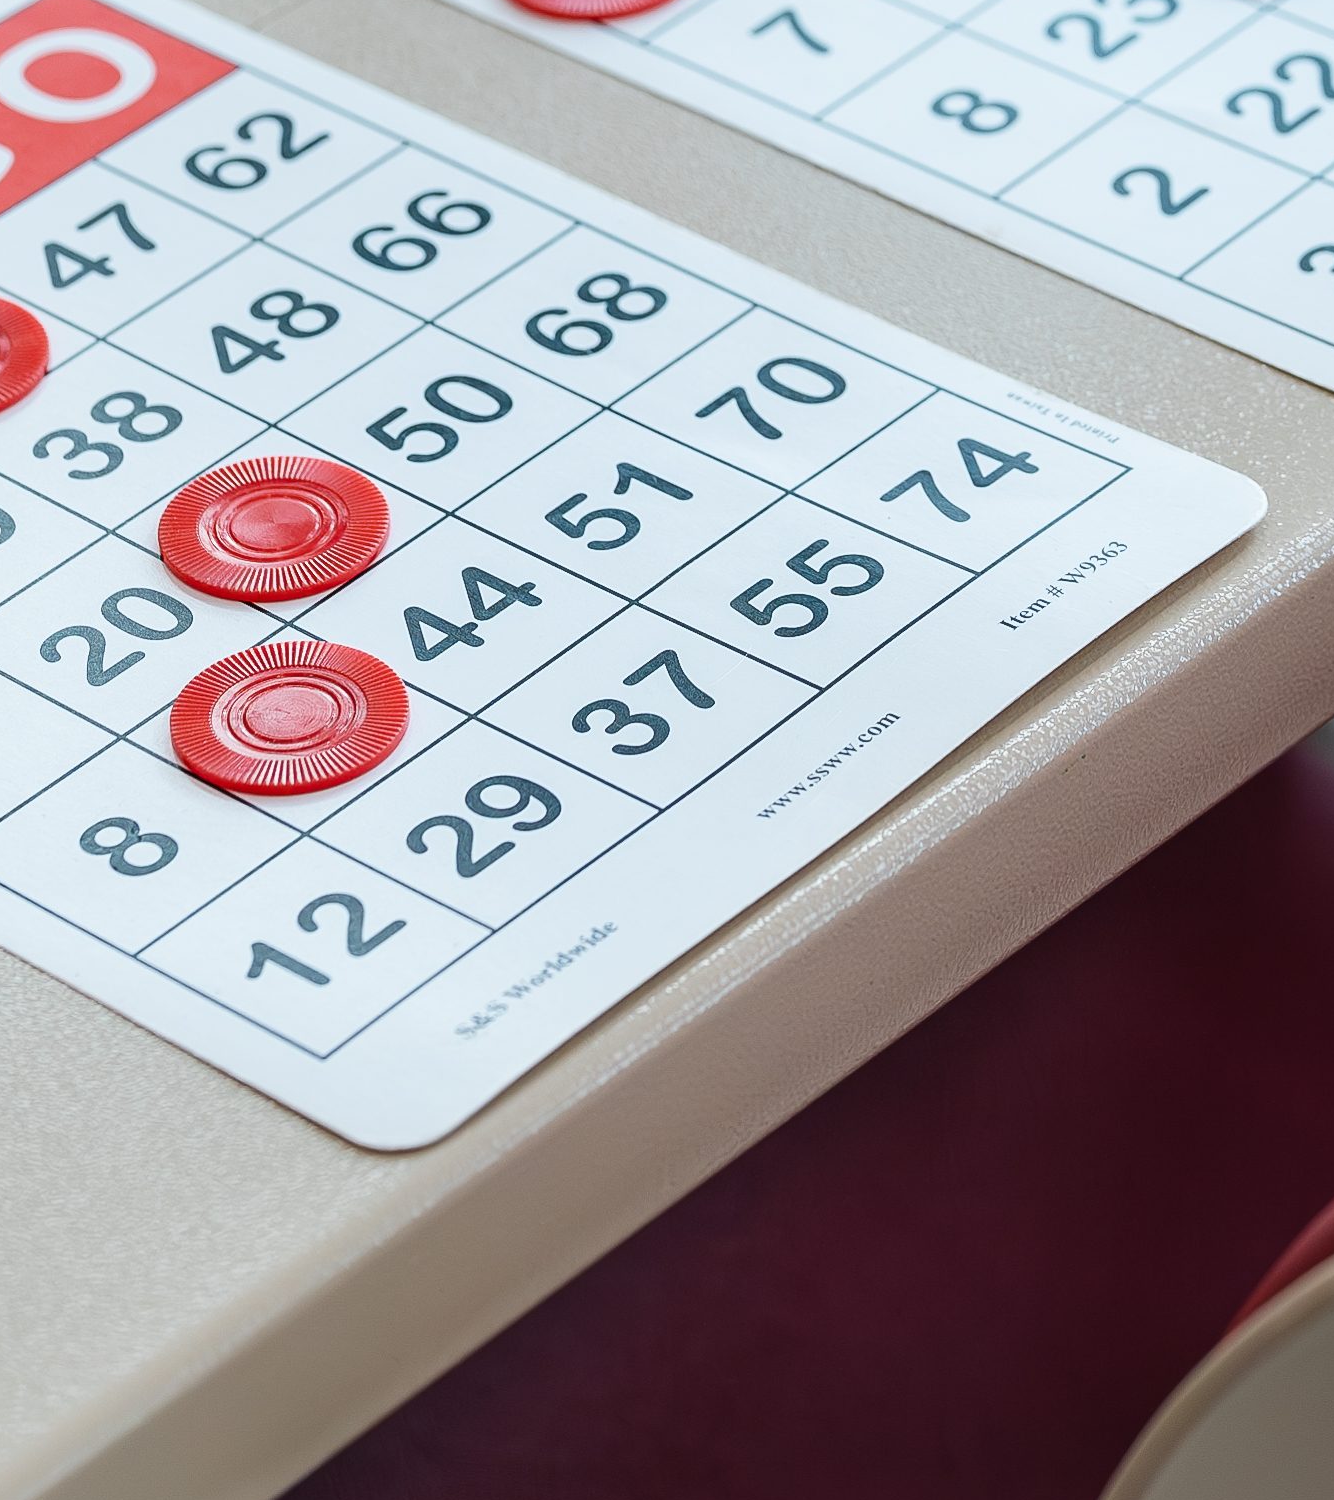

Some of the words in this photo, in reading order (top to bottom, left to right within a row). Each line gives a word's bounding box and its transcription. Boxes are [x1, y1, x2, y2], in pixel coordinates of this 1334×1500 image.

[749, 6, 833, 60] 7
[927, 85, 1022, 137] 8
[40, 201, 161, 294] 47
[183, 108, 331, 193] 62
[1109, 163, 1211, 218] 2
[30, 389, 185, 484] 38
[206, 286, 342, 379] 48
[350, 188, 494, 274] 66
[38, 585, 196, 689] 20
[363, 372, 515, 467] 50
[522, 270, 670, 357] 68
[77, 814, 181, 880] 8
[398, 565, 545, 667] 44
[543, 459, 695, 555] 51
[693, 354, 849, 444] 70
[998, 598, 1051, 631] Item
[1045, 584, 1065, 598] #
[1057, 541, 1128, 585] W9363
[246, 890, 409, 992] 12
[404, 771, 565, 881] 29
[569, 646, 718, 758] 37
[728, 537, 888, 641] 55
[878, 435, 1042, 525] 74
[756, 712, 901, 819] www.ssww.com
[454, 999, 509, 1040] S&S
[502, 921, 618, 999] Worldwide
